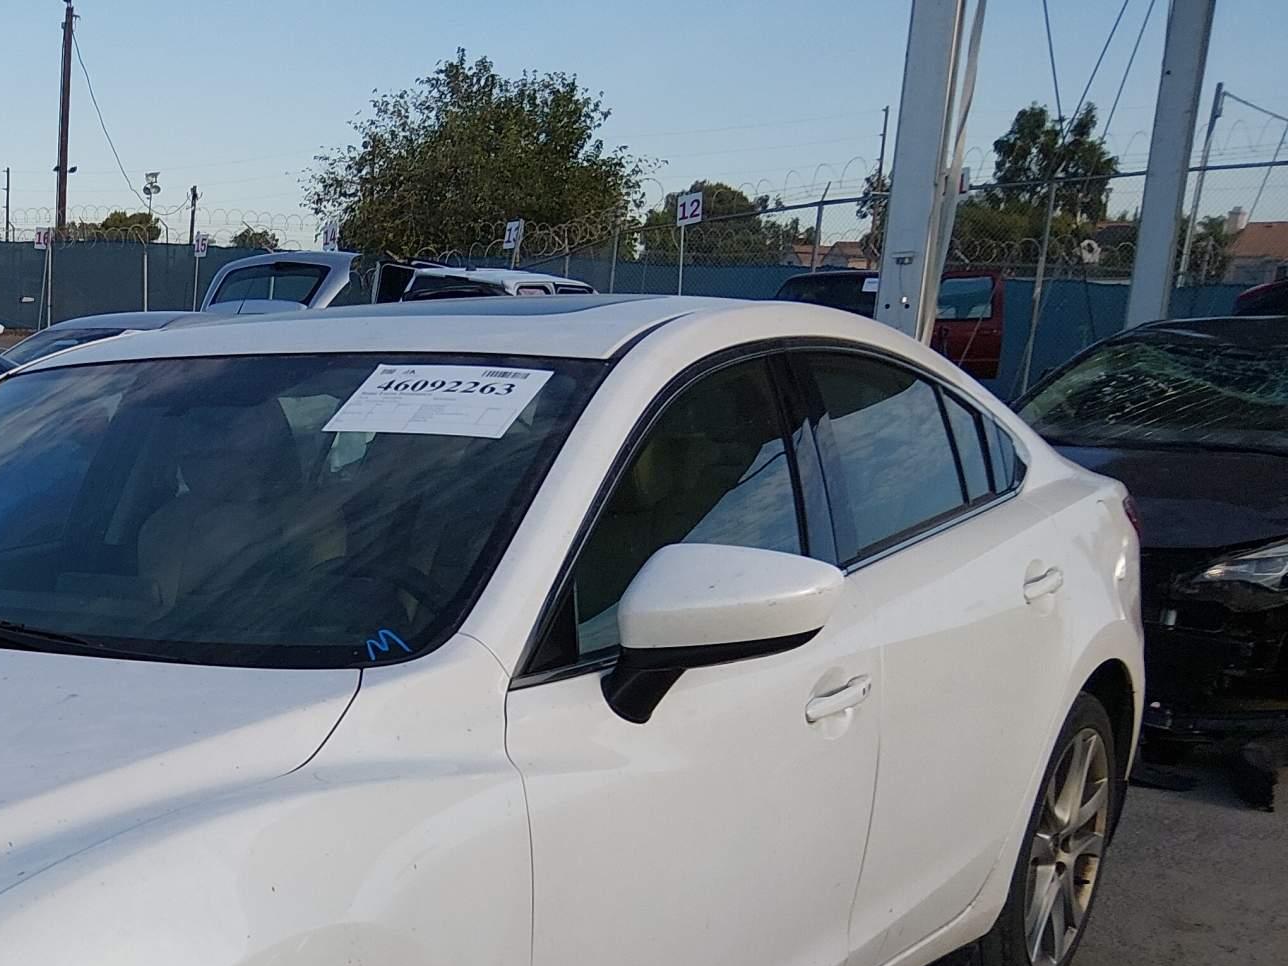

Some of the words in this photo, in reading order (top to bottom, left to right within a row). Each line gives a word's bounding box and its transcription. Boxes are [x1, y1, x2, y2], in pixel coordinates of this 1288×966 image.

[678, 199, 700, 221] 12
[35, 231, 49, 245] 16
[196, 238, 207, 252] 15
[324, 228, 336, 246] 14
[376, 378, 516, 396] 46092263
[366, 629, 412, 660] M
